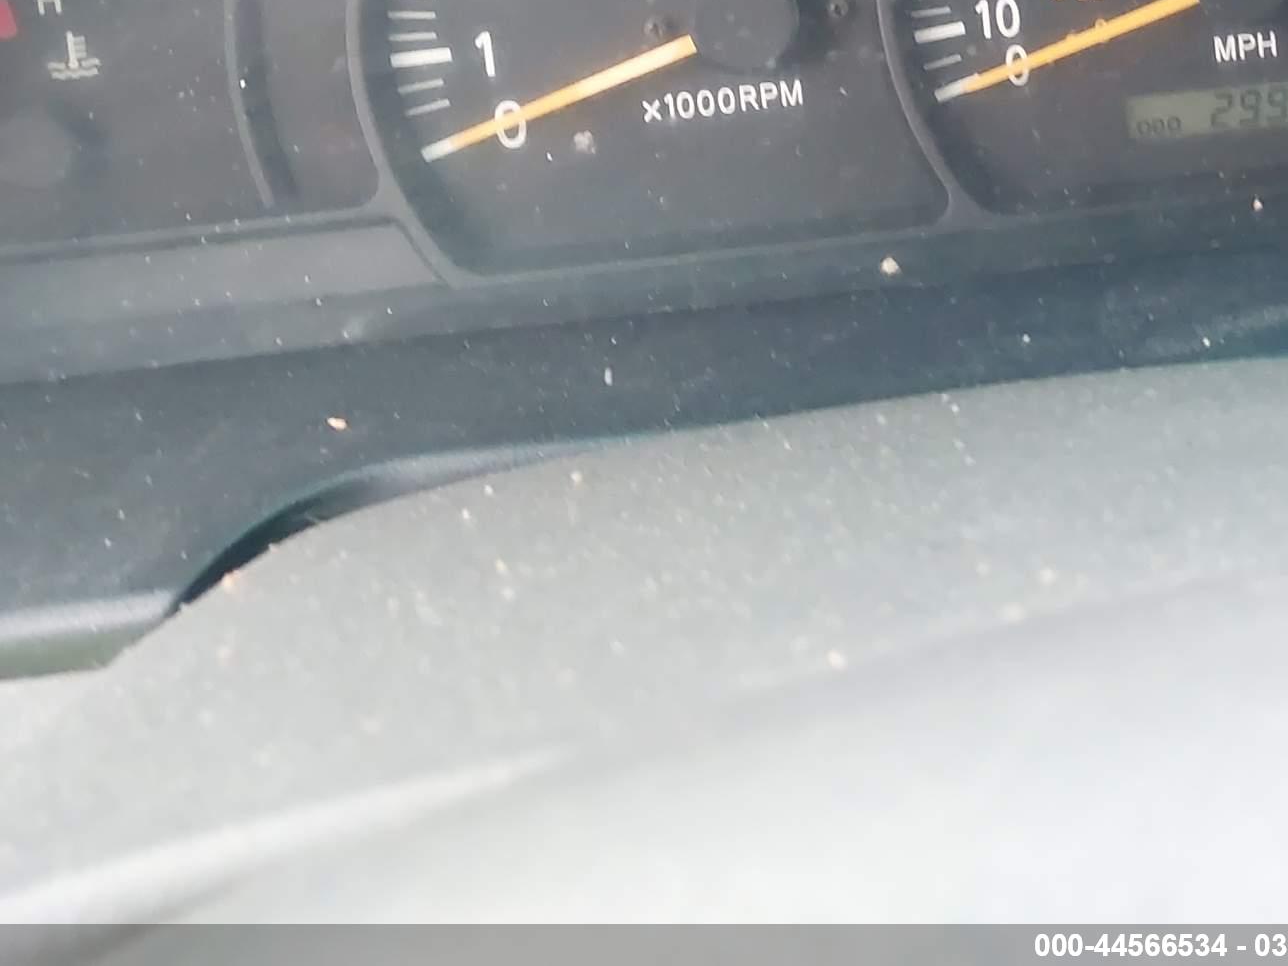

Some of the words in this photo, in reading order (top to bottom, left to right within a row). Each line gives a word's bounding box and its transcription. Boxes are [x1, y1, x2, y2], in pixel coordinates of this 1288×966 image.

[474, 31, 496, 78] 1
[1005, 43, 1030, 87] 0
[1213, 30, 1279, 64] MPH
[494, 99, 527, 150] 0
